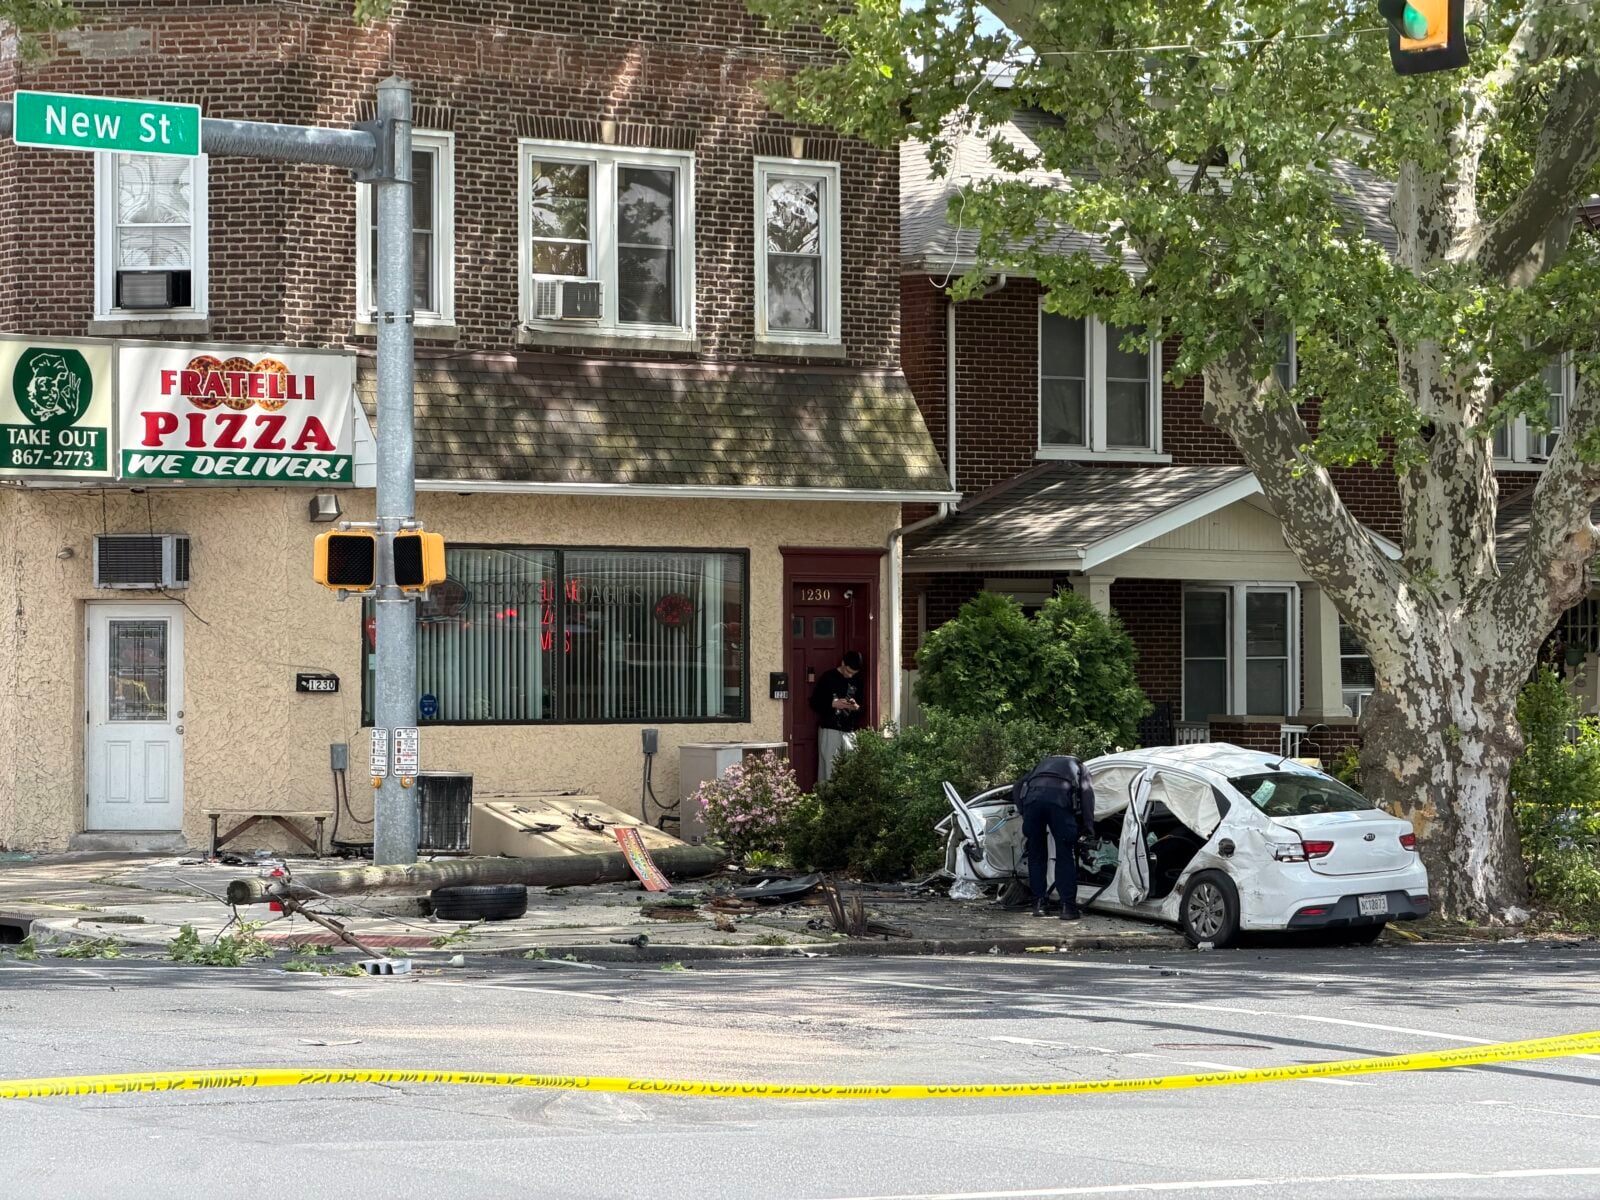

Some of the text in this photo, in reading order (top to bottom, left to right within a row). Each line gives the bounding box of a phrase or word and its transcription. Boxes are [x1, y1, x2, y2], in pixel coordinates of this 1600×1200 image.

[45, 104, 171, 144] New St
[160, 369, 315, 401] FRATELLI
[7, 428, 98, 447] TAKE OUT
[140, 411, 337, 451] PIZZA
[12, 448, 94, 467] 867-2773
[127, 453, 348, 480] WE DELIVER!
[801, 588, 831, 601] 1230
[309, 680, 335, 691] 1230
